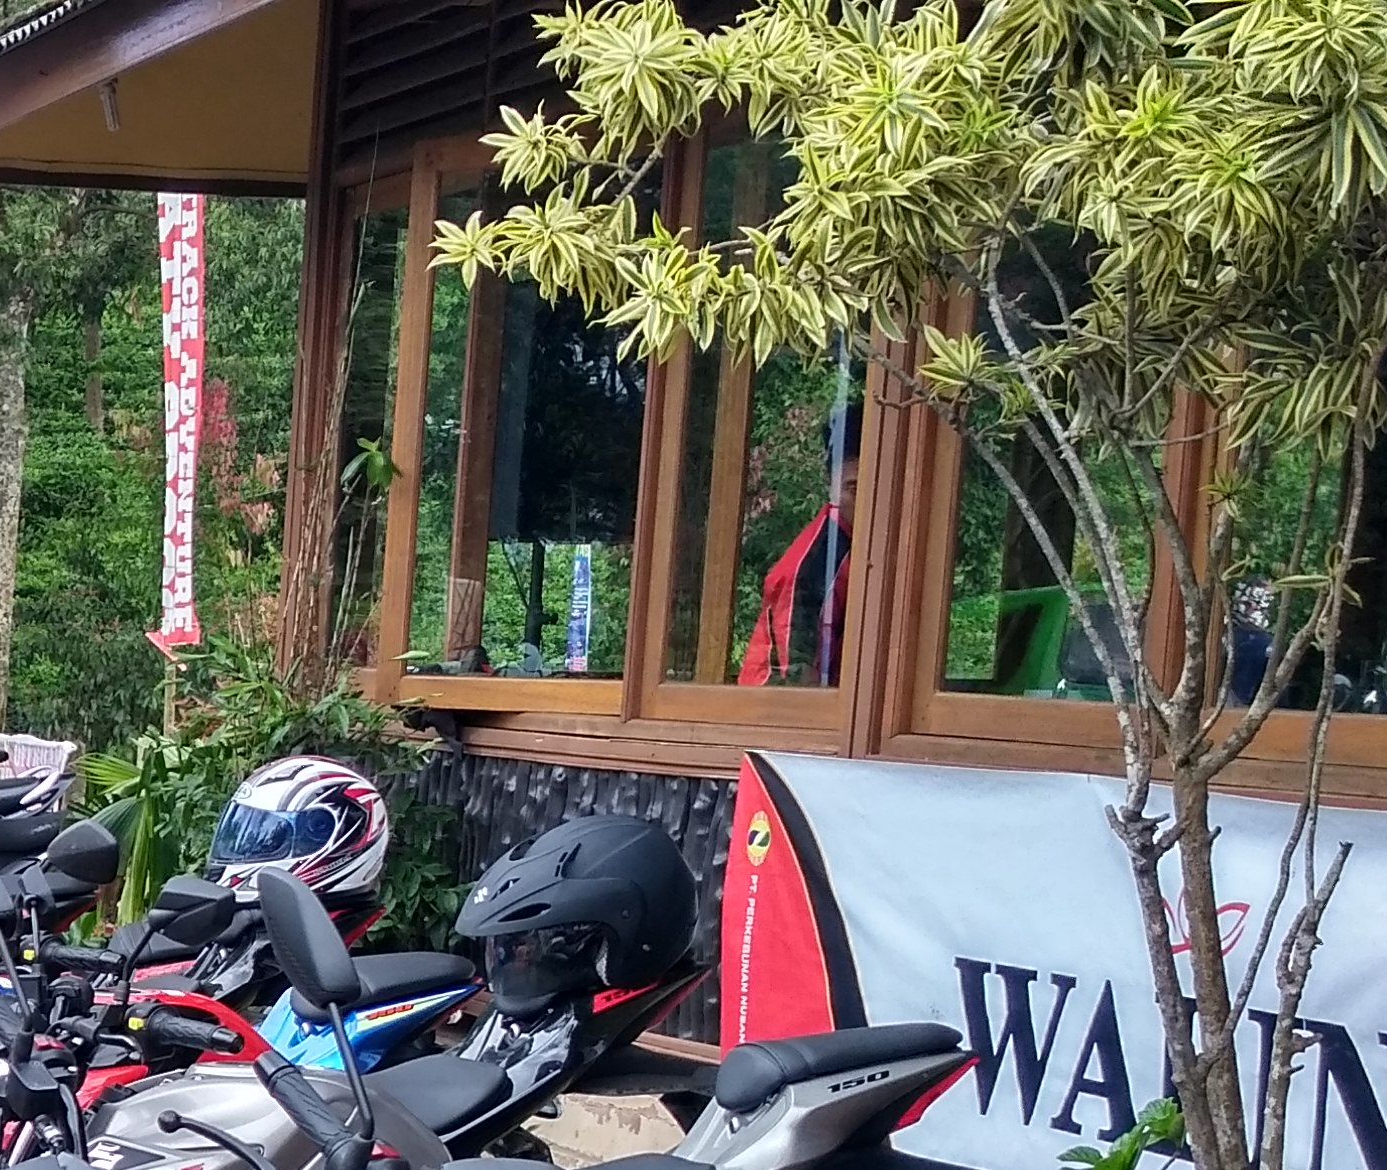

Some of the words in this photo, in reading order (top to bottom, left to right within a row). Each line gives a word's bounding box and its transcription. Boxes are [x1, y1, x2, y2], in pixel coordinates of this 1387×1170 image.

[171, 351, 199, 632] ADVENTURE
[749, 874, 759, 894] PT.
[740, 897, 756, 993] PERKEBUNAN
[827, 1071, 890, 1093] 150
